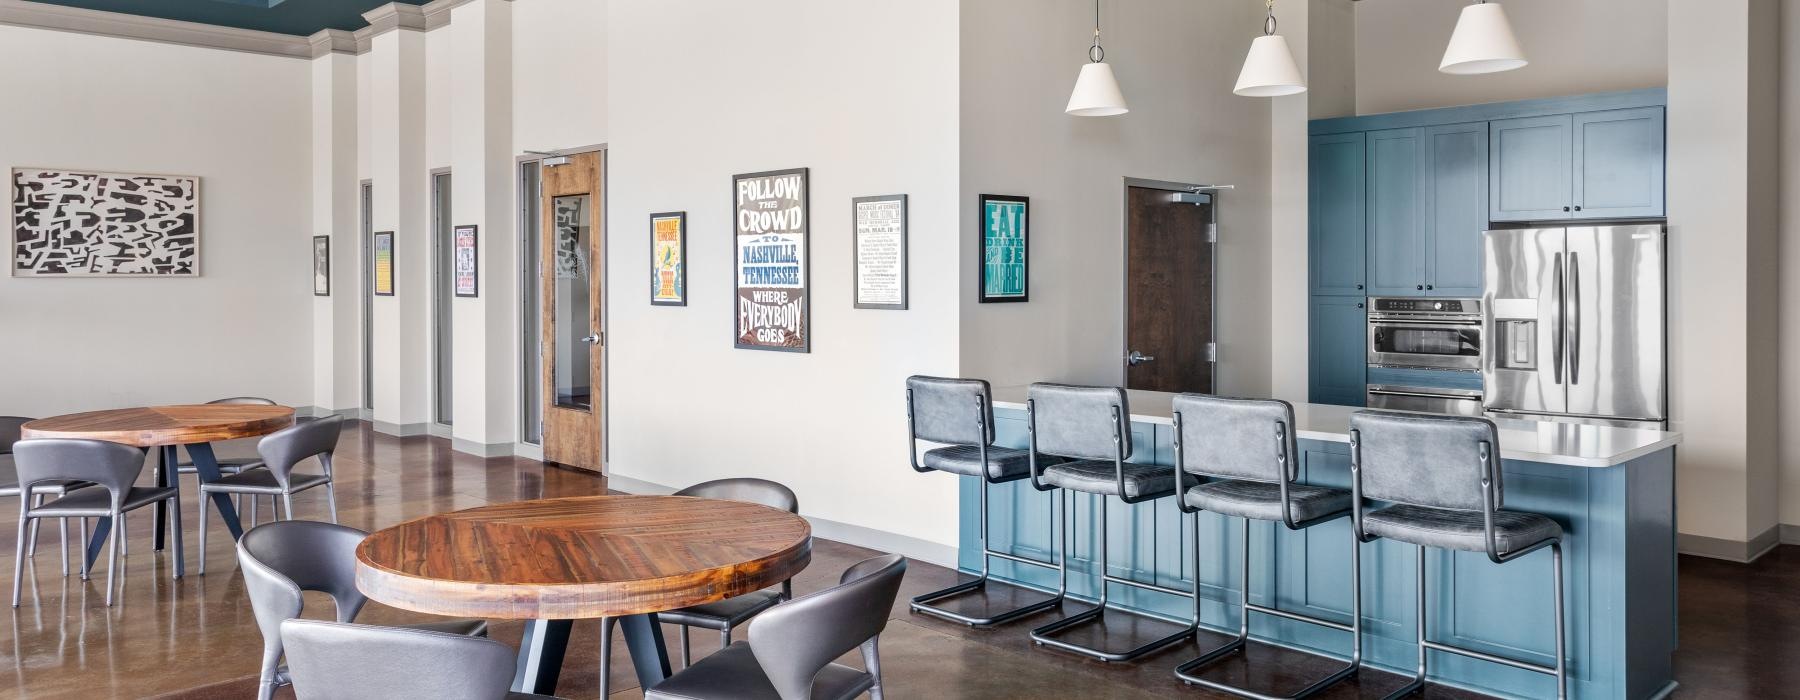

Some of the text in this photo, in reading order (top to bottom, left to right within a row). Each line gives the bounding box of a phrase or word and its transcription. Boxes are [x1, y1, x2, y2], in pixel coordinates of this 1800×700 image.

[739, 176, 802, 206] FOLLOW
[758, 201, 777, 209] THE
[739, 206, 802, 234] CROWD
[986, 204, 1024, 238] EAT
[986, 238, 1023, 247] DRINK
[743, 244, 799, 265] NASHVILLE,
[1001, 247, 1023, 263] BE
[743, 266, 799, 285] TENNESSEE
[985, 263, 1024, 293] MARRIED
[753, 290, 788, 305] WHERE
[740, 295, 802, 339] EVERYBODY
[757, 329, 785, 343] GOES
